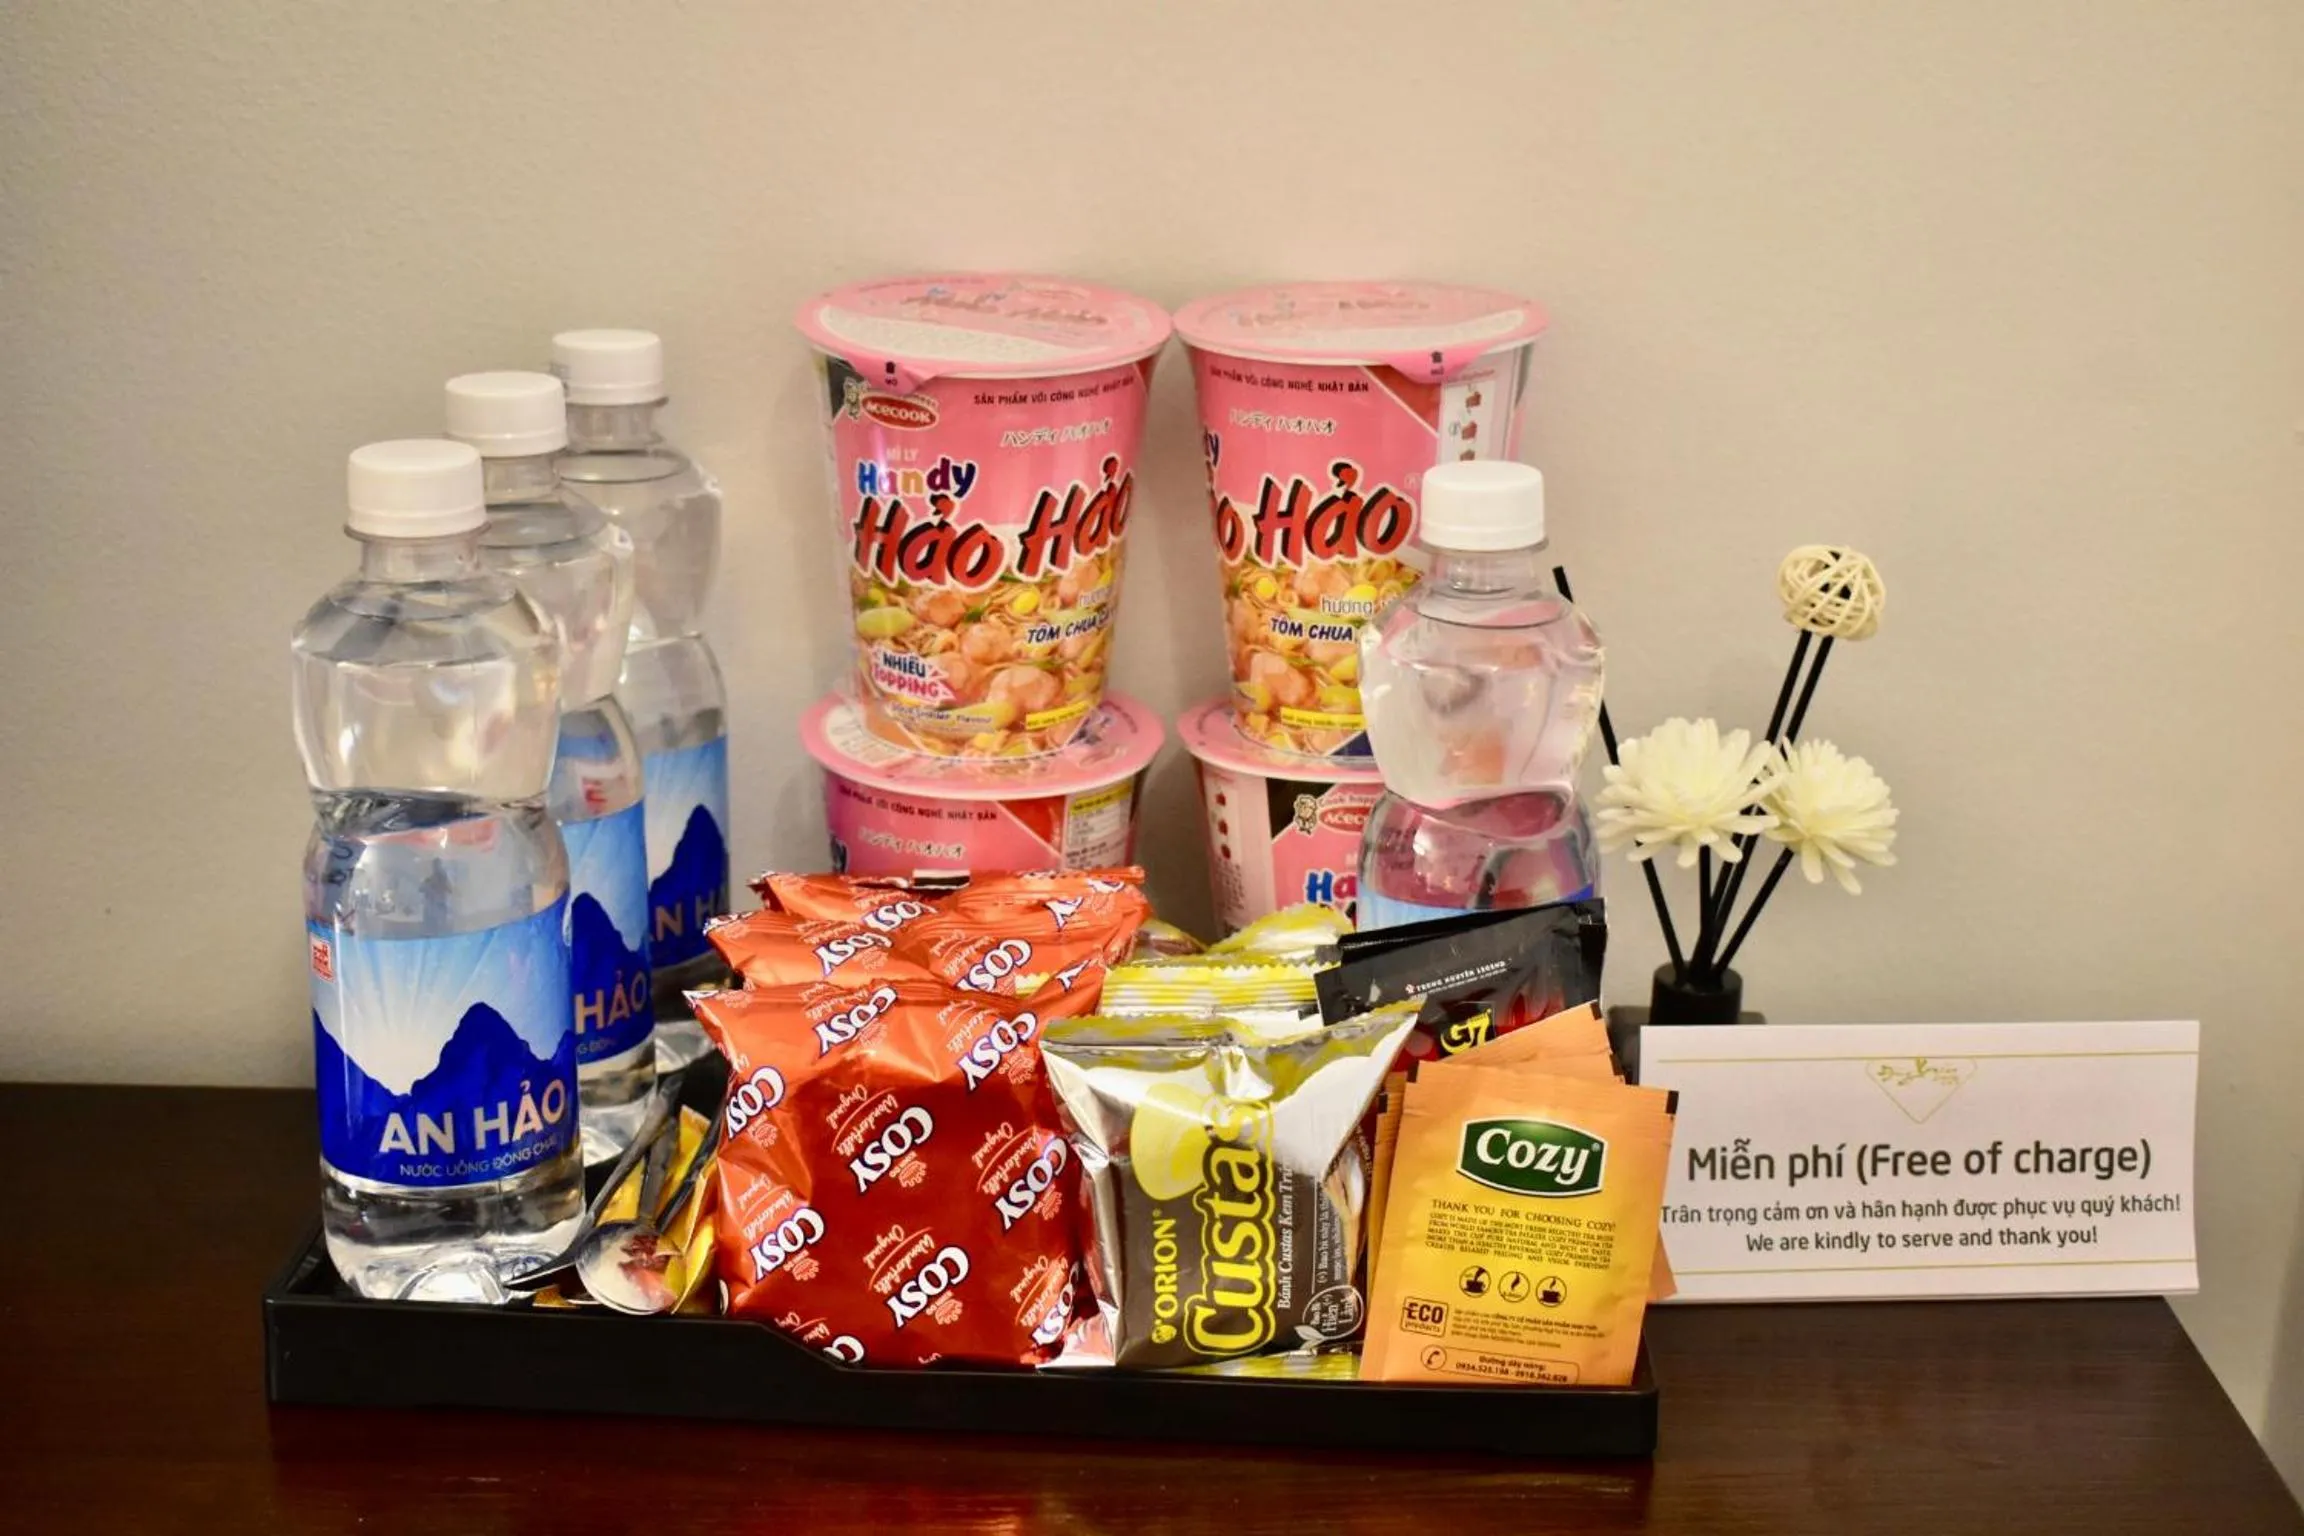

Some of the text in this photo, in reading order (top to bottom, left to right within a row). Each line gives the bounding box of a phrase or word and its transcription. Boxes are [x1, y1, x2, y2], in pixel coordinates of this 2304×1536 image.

[858, 457, 977, 498] Handy
[854, 495, 1001, 588] Hảo
[1252, 461, 1413, 568] Hảo
[1308, 624, 1354, 641] CHUA
[575, 969, 647, 1035] HẢO
[814, 985, 898, 1057] COSY
[955, 1010, 1038, 1092] COSY
[378, 1079, 566, 1156] AN HẢO
[726, 1065, 786, 1139] COSY
[849, 1105, 935, 1193] COSY
[994, 1136, 1069, 1231] COSY
[1475, 1127, 1591, 1186] Cozy
[1687, 1138, 2152, 1187] Miễn phí (Free of charge)
[749, 1206, 827, 1282] COSY
[1193, 1100, 1265, 1350] Custas
[1277, 1195, 1293, 1226] Kem
[1432, 1199, 1469, 1213] THANK
[1473, 1205, 1495, 1217] YOU
[1500, 1208, 1520, 1220] FOR
[1525, 1211, 1581, 1228] CHOOSING
[1660, 1193, 2181, 1226] Trân trọng cảm ơn và hân hạnh được phục vụ quý khách!
[1746, 1225, 2098, 1253] We are kindly to serve and thank you!
[1152, 1217, 1178, 1320] ORION
[1277, 1228, 1293, 1273] Custas
[886, 1245, 972, 1329] COSY
[1277, 1276, 1293, 1309] Bánh
[1406, 1301, 1444, 1325] ECO
